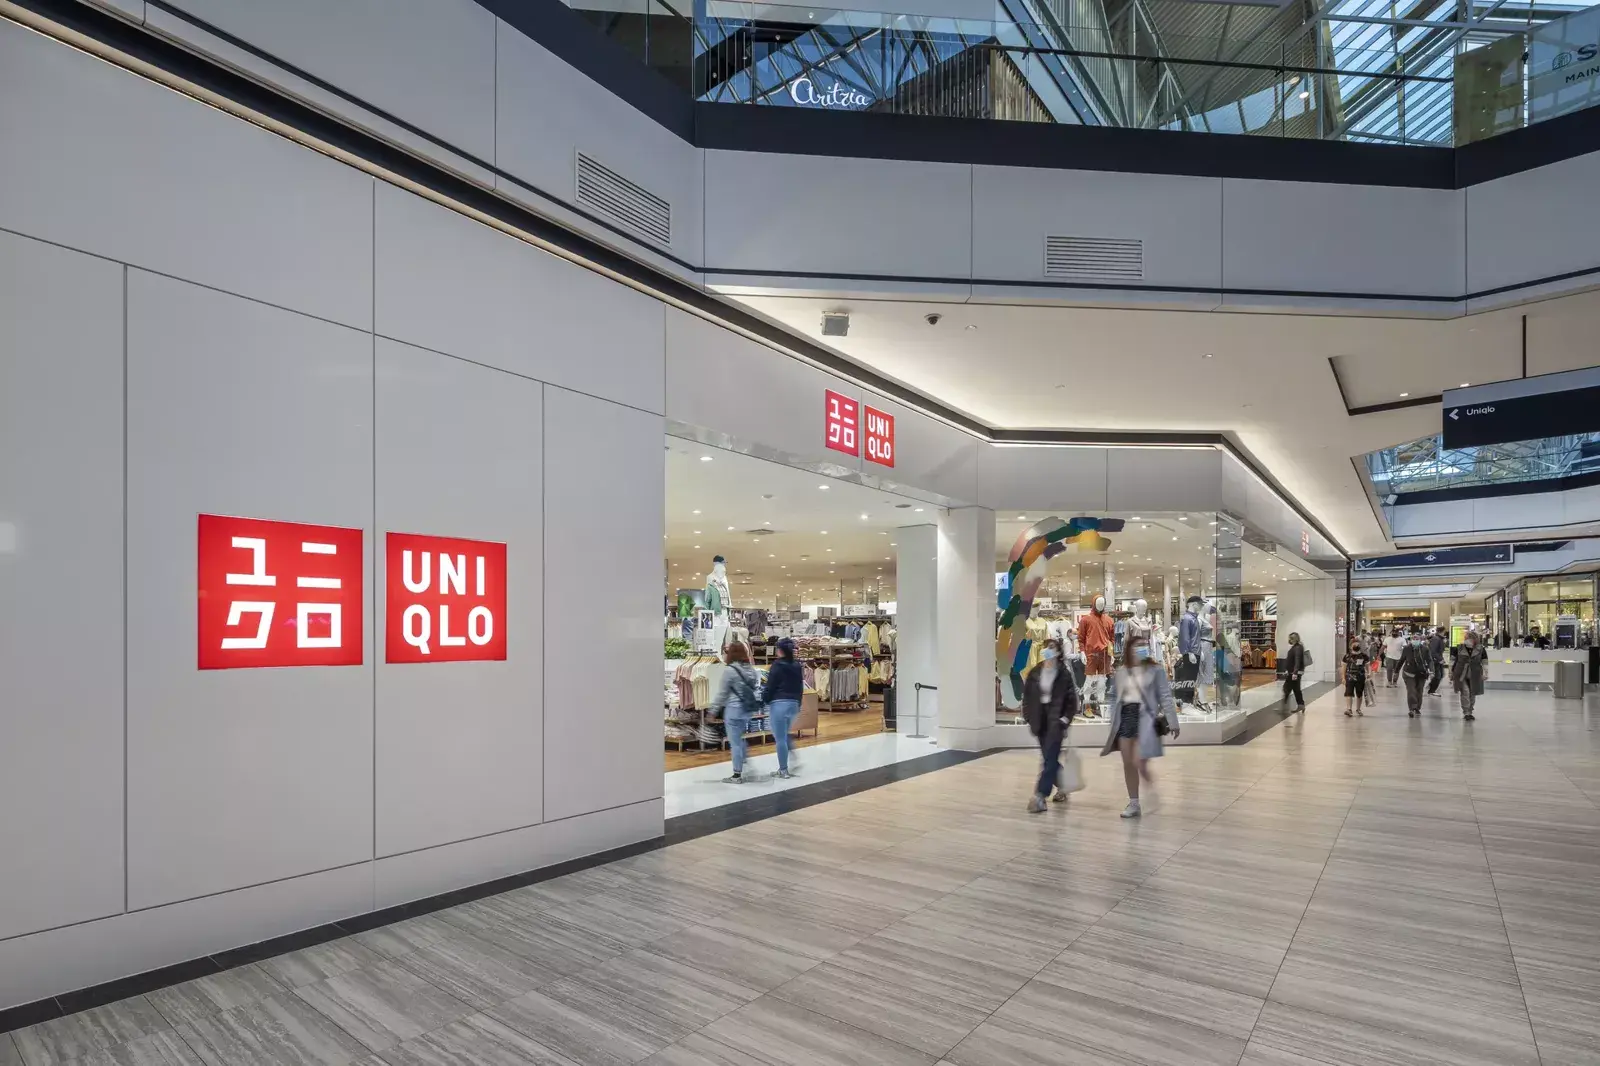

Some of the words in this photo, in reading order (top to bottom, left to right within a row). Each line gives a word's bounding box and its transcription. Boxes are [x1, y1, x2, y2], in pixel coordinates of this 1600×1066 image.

[829, 398, 854, 425] ユニ
[1466, 406, 1495, 415] Uniqlo
[829, 422, 854, 448] クロ
[868, 413, 889, 438] UNI
[868, 436, 891, 459] QLO
[226, 537, 342, 588] ユニ
[402, 550, 485, 596] UNI
[221, 601, 342, 649] クロ
[402, 603, 493, 654] QLO
